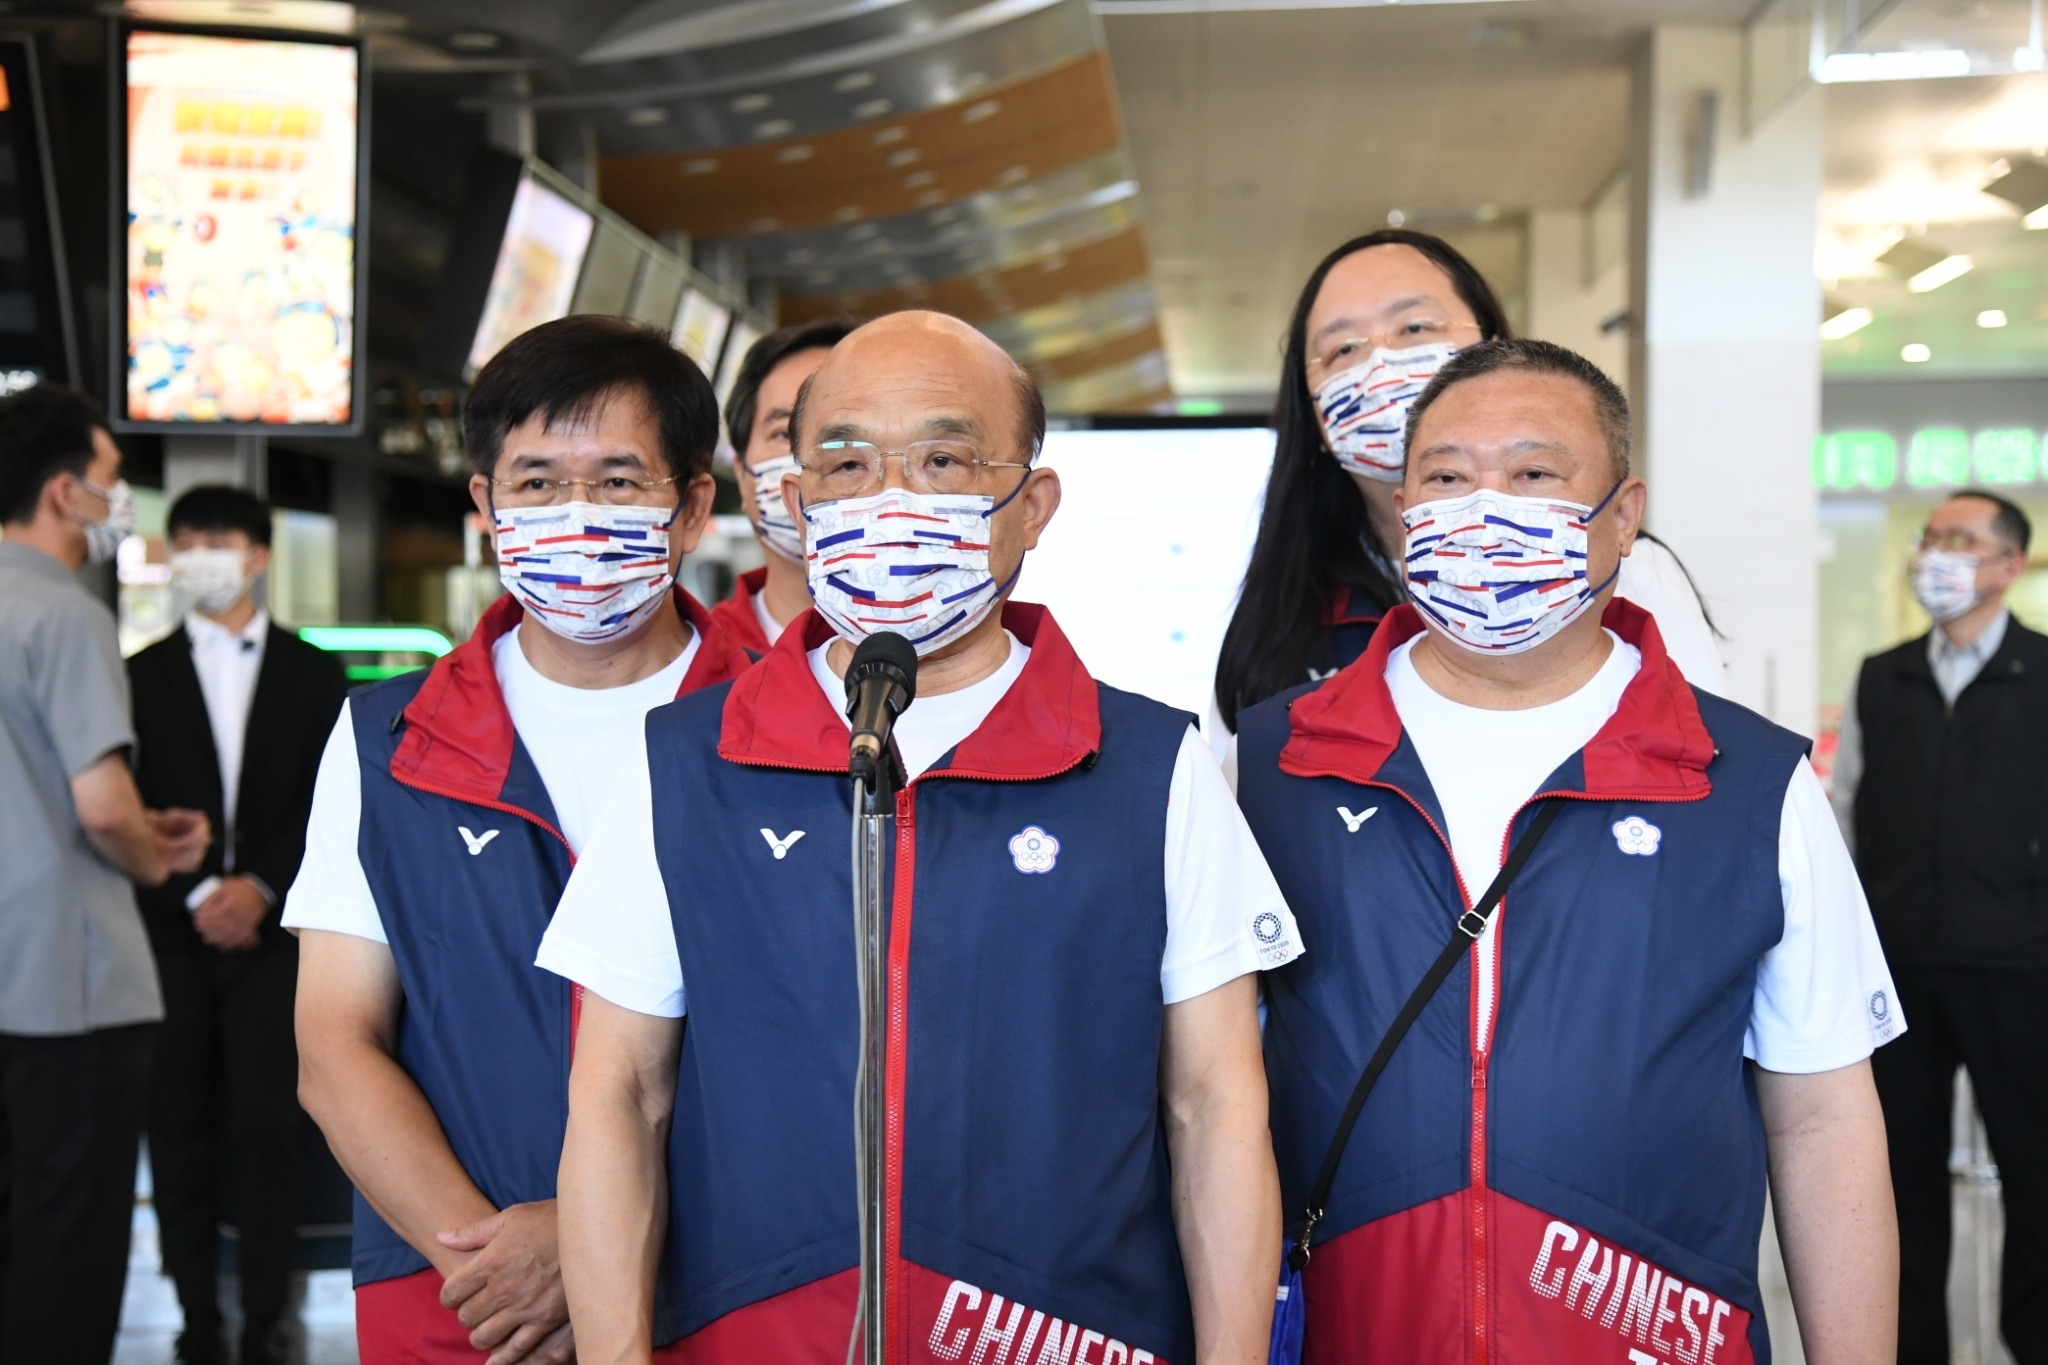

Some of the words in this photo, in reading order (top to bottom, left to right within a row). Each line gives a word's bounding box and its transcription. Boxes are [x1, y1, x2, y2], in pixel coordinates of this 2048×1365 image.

[1259, 945, 1277, 954] TOKYO
[1277, 940, 1290, 949] 2020
[928, 1279, 1154, 1365] CHIN
[1529, 1220, 1731, 1365] CHINESE
